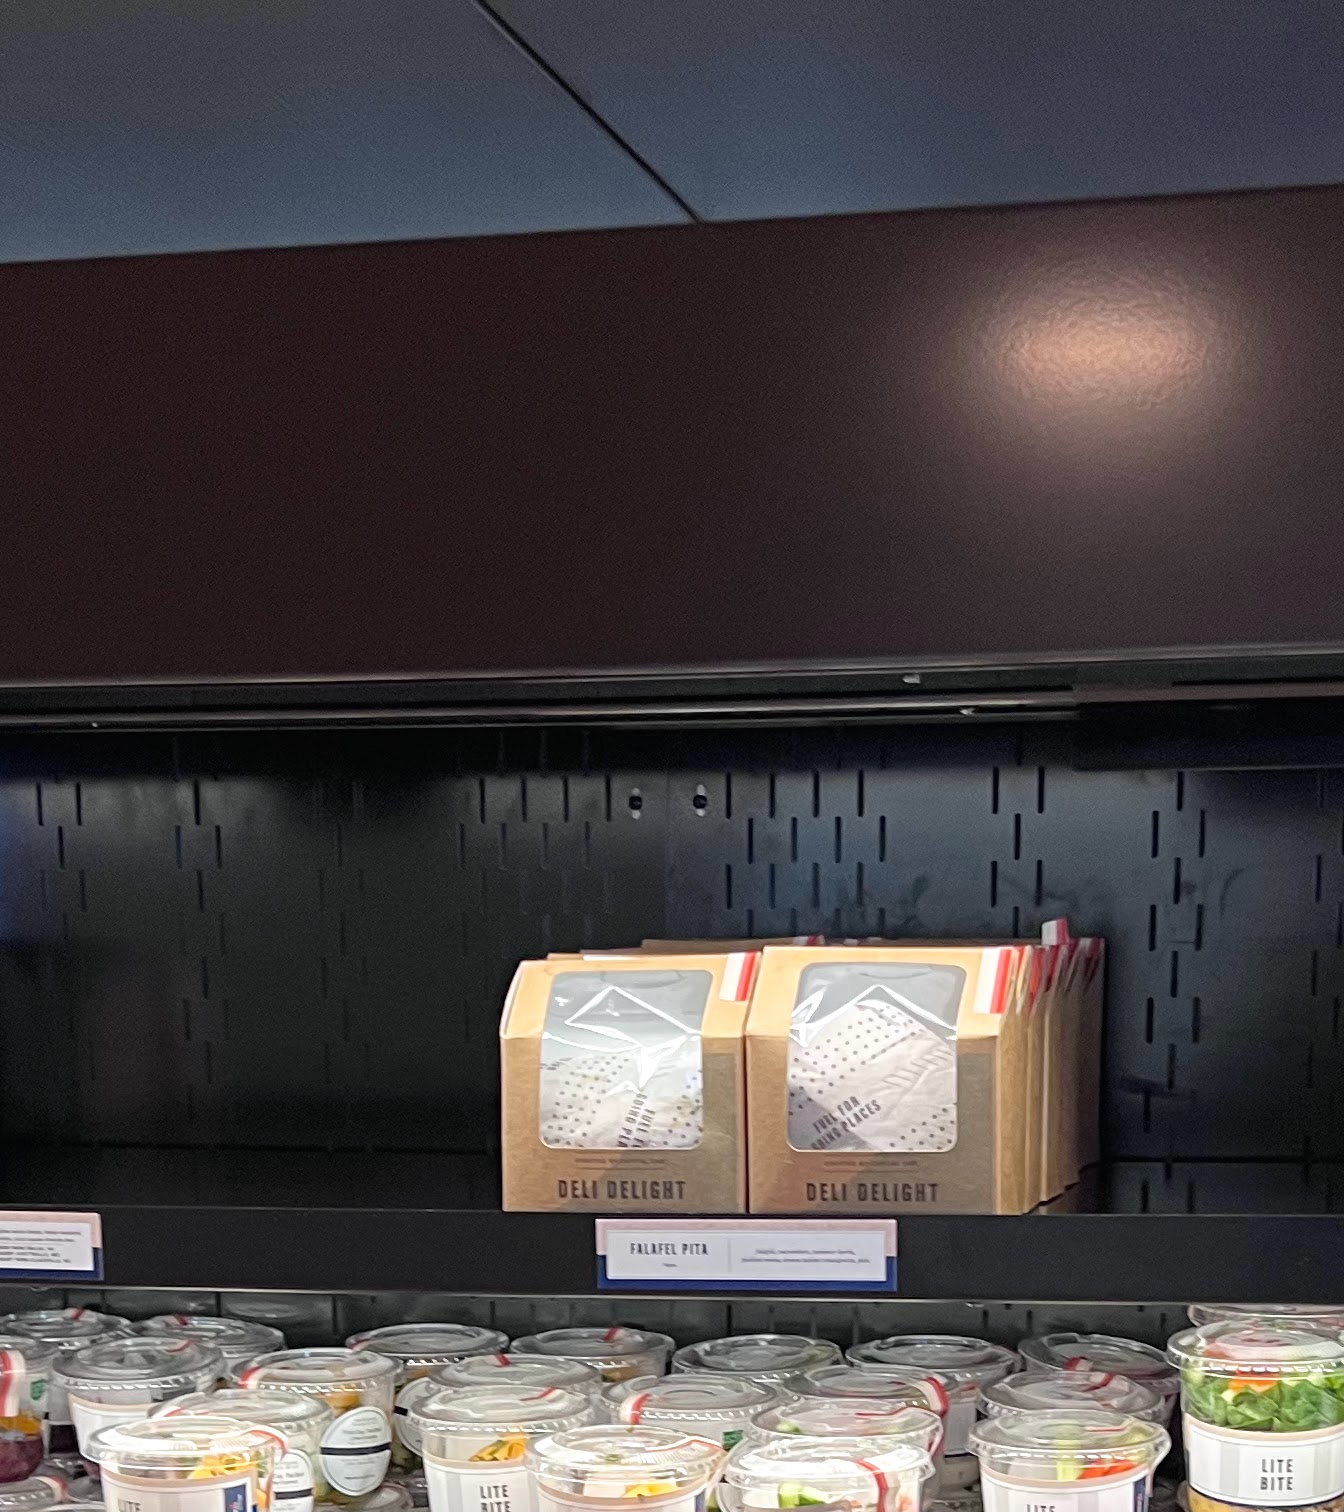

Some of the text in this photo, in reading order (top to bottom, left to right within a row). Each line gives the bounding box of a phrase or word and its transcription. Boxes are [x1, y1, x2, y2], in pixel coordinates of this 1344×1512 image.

[812, 1096, 861, 1134] FUEL FOR
[840, 1099, 881, 1133] PLACES
[558, 1179, 686, 1200] DELI DELIGHT
[806, 1182, 939, 1203] DELI DELIGHT
[630, 1242, 708, 1255] FALAFEL PITA
[1261, 1458, 1293, 1474] LITE
[479, 1484, 508, 1499] LITE
[1259, 1476, 1294, 1492] BITE
